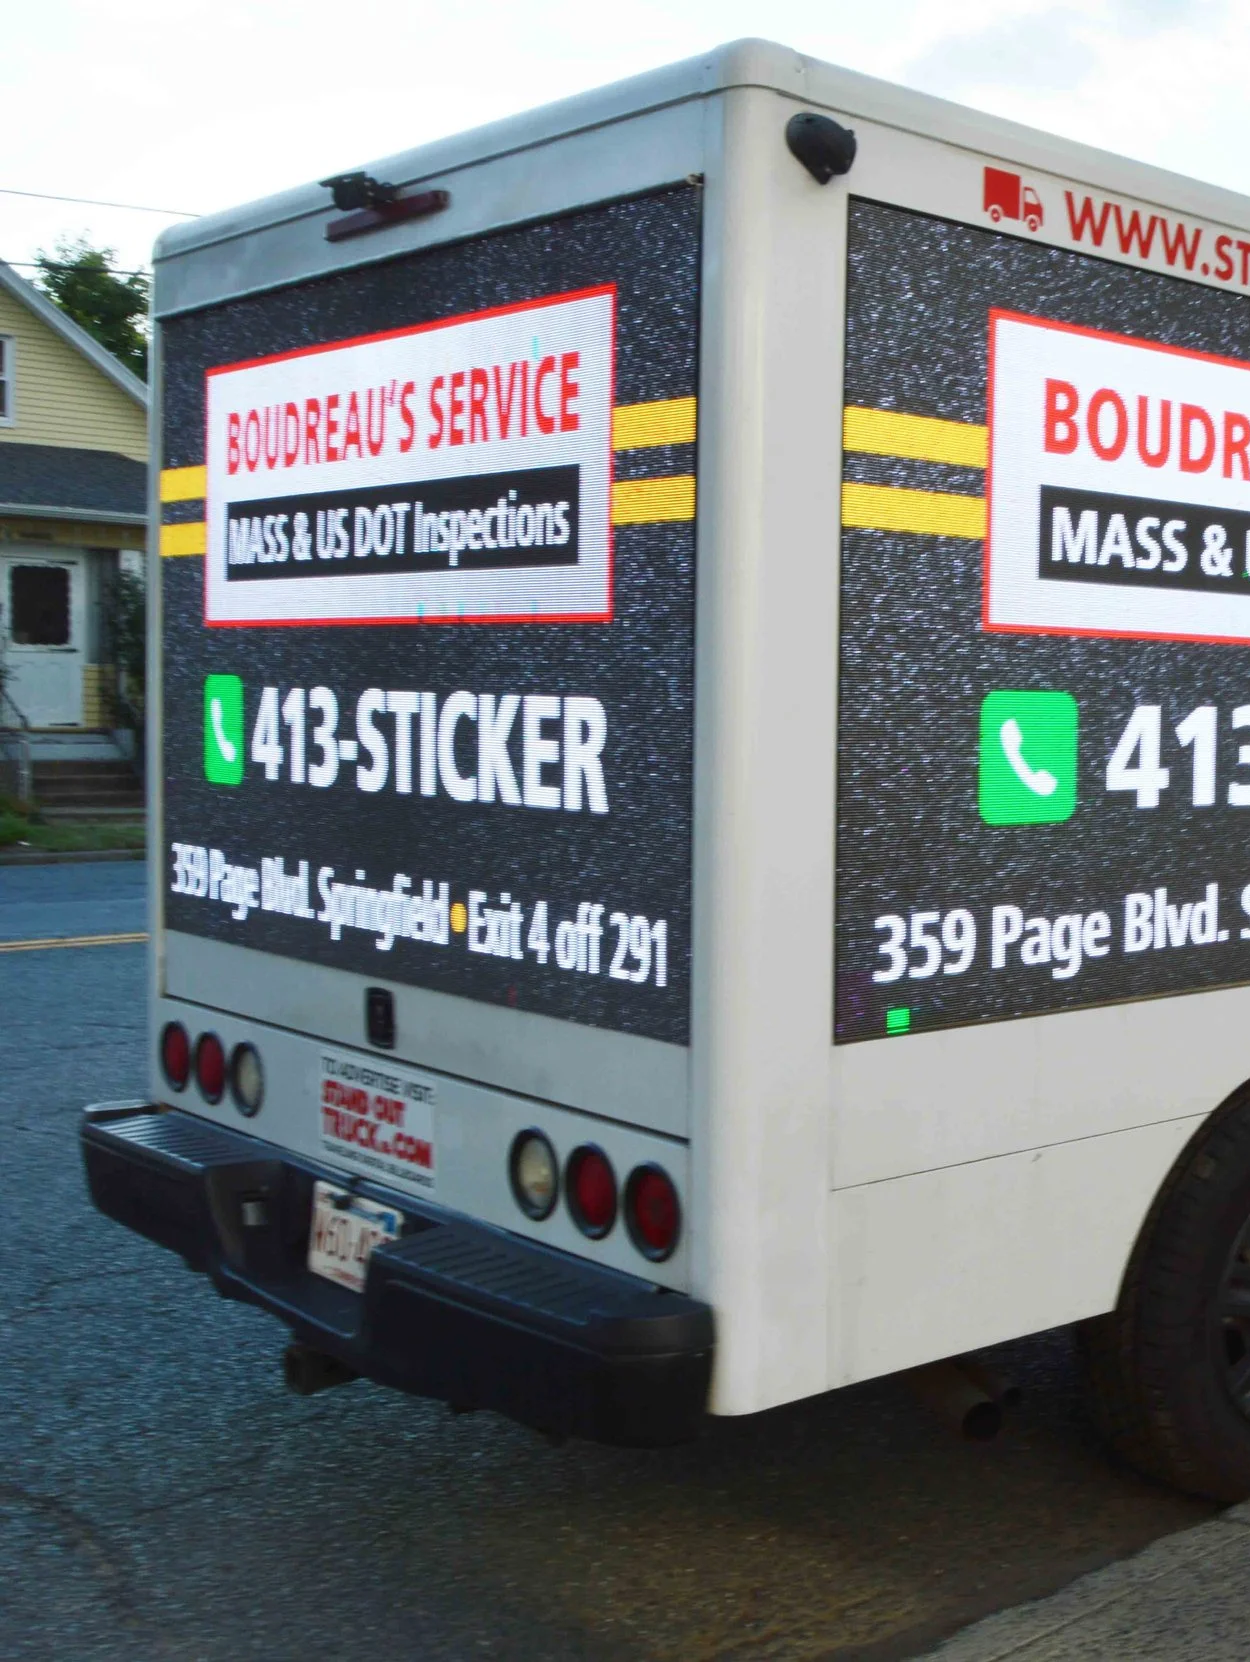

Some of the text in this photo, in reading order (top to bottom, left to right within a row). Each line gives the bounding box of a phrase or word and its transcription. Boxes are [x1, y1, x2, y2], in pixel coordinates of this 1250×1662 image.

[227, 351, 580, 475] BOUDREAU'S SERVICE
[228, 489, 571, 566] MASS & US DOT Inspections
[1051, 506, 1188, 573] MASS
[1200, 524, 1233, 580] &
[251, 686, 609, 814] 413-STICKER
[209, 848, 259, 920] Page
[317, 866, 449, 950] Springfield
[468, 891, 524, 960] Exit
[528, 900, 550, 963] 4
[555, 902, 605, 974] off
[609, 911, 668, 987] 291
[872, 910, 976, 982] 359
[990, 904, 1110, 979] Page
[1123, 884, 1229, 952] Blvd.
